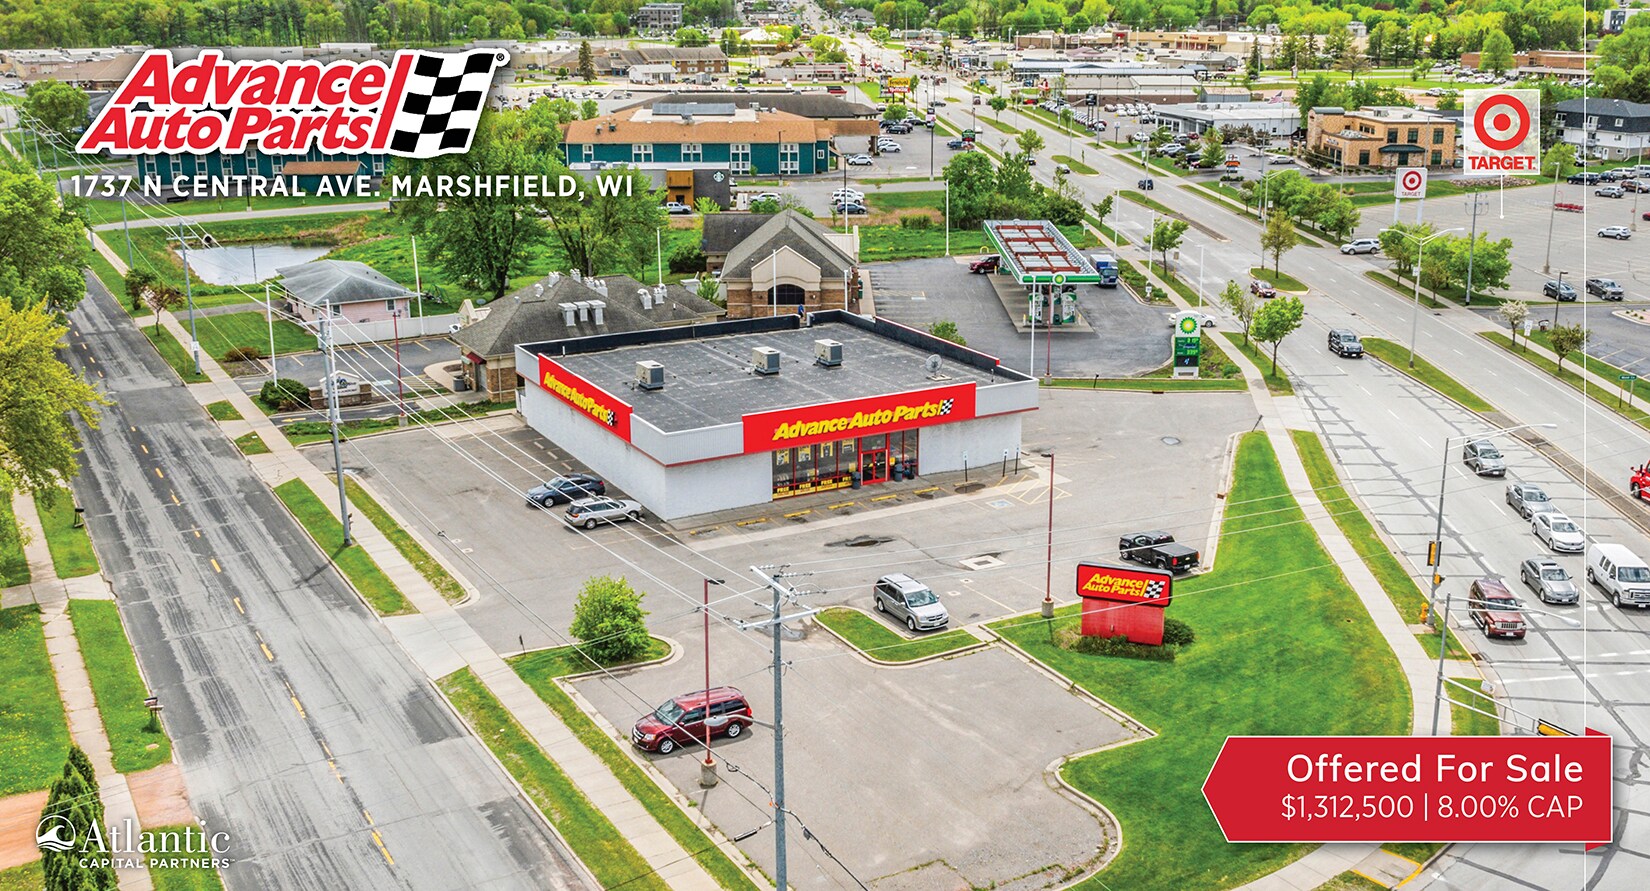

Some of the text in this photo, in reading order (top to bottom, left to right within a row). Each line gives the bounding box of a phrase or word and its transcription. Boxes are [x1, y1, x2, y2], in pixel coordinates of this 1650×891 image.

[543, 371, 572, 400] Advance
[570, 387, 588, 410] Auto
[772, 401, 939, 441] Advance Auto Parts
[1082, 582, 1141, 597] Auto Parts
[1089, 573, 1144, 588] Advance
